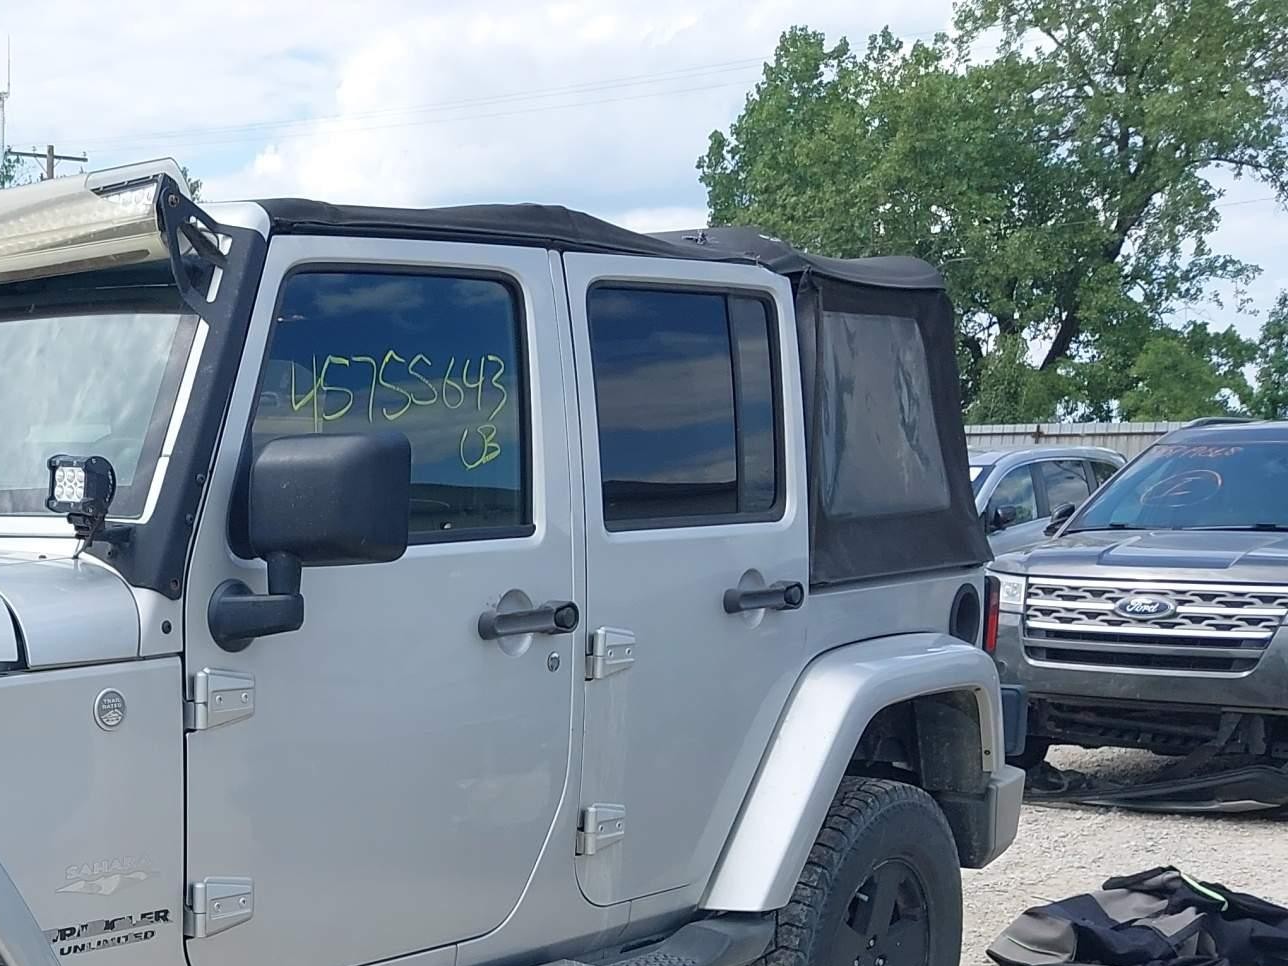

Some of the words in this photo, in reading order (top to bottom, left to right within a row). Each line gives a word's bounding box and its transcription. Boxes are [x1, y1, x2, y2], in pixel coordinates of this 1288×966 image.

[291, 350, 508, 433] 45755643
[1126, 599, 1160, 613] Ford
[64, 854, 153, 880] SAHARA
